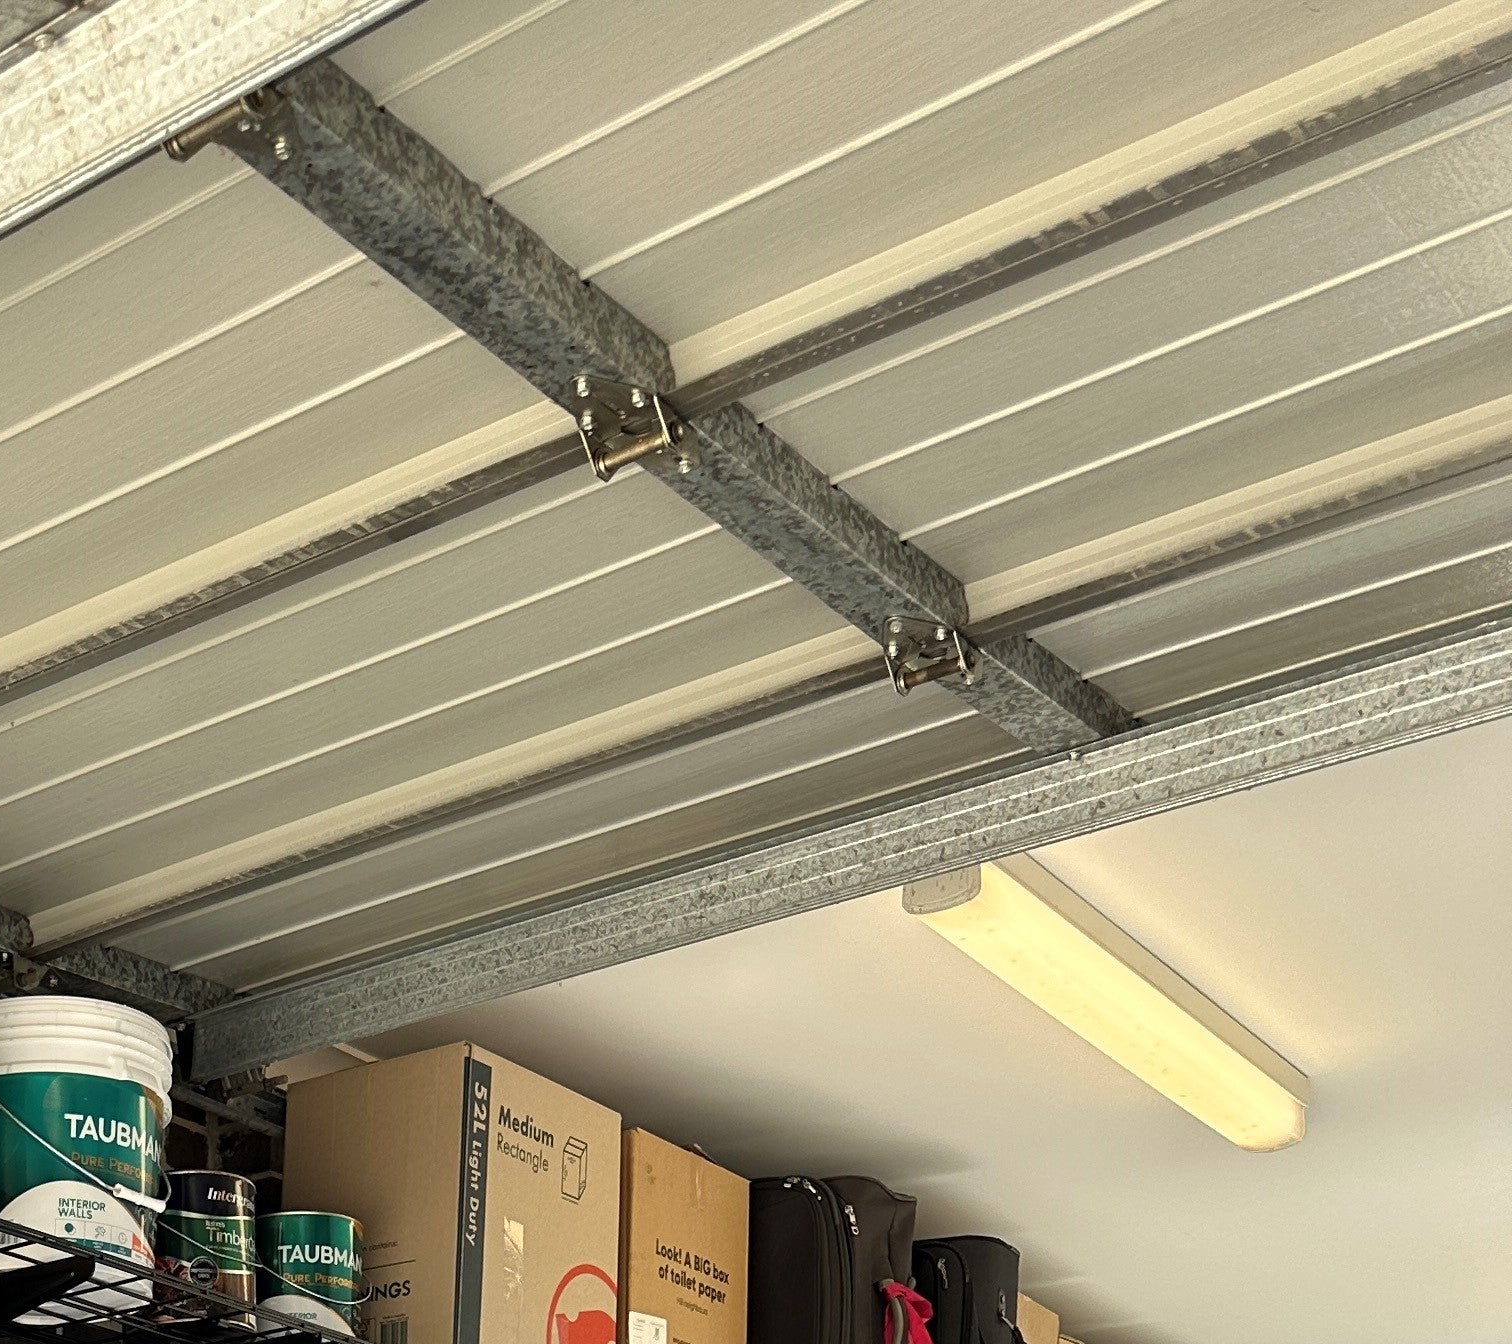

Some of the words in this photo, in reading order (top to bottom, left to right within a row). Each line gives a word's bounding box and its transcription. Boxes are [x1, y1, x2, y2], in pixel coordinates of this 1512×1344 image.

[472, 1082, 488, 1134] 52L
[497, 1104, 555, 1149] Medium
[70, 1151, 105, 1168] PURE
[468, 1140, 483, 1191] Light
[496, 1132, 549, 1174] Rectangle
[58, 1197, 106, 1213] INTERIOR
[58, 1207, 93, 1220] WALLS
[465, 1196, 480, 1247] Duty
[283, 1272, 311, 1284] PURE
[655, 1238, 682, 1265] Look!
[683, 1251, 692, 1269] A
[693, 1254, 711, 1276] BIG
[712, 1263, 730, 1285] box
[658, 1264, 669, 1281] of
[670, 1268, 697, 1292] toilet
[698, 1282, 727, 1304] paper
